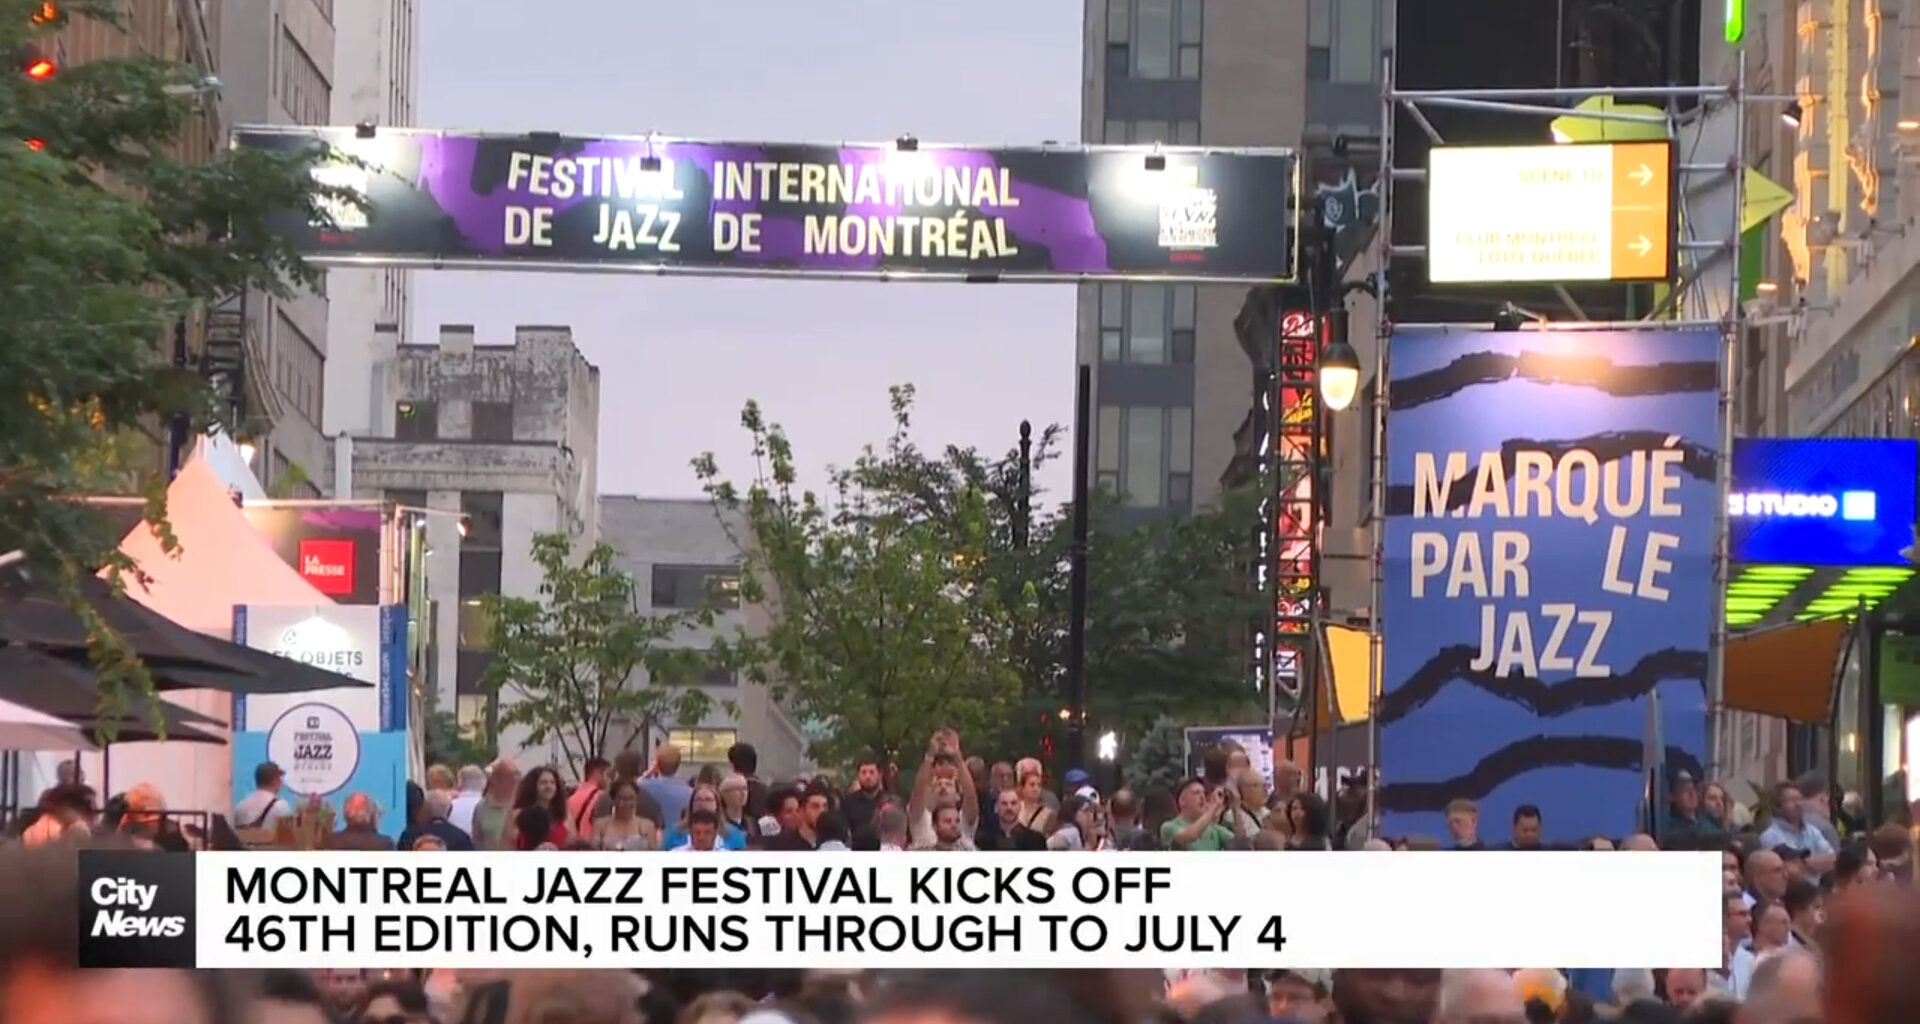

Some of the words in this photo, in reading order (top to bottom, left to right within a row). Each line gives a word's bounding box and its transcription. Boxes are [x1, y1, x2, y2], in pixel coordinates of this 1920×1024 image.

[713, 161, 1020, 206] INTERNATIONAL
[504, 206, 553, 246] DE
[593, 203, 681, 252] JAZZ
[713, 212, 762, 252] DE
[804, 209, 1018, 259] MONTRÉAL
[1413, 435, 1684, 526] MARQUÉ
[1746, 493, 1838, 516] STUDIO
[304, 555, 320, 565] LA
[304, 564, 345, 576] PRESSE
[1411, 532, 1531, 598] PAR
[1602, 526, 1680, 600] LE
[1470, 604, 1613, 678] JAZZ
[301, 651, 363, 666] OBJETS
[294, 744, 333, 760] JAZZ
